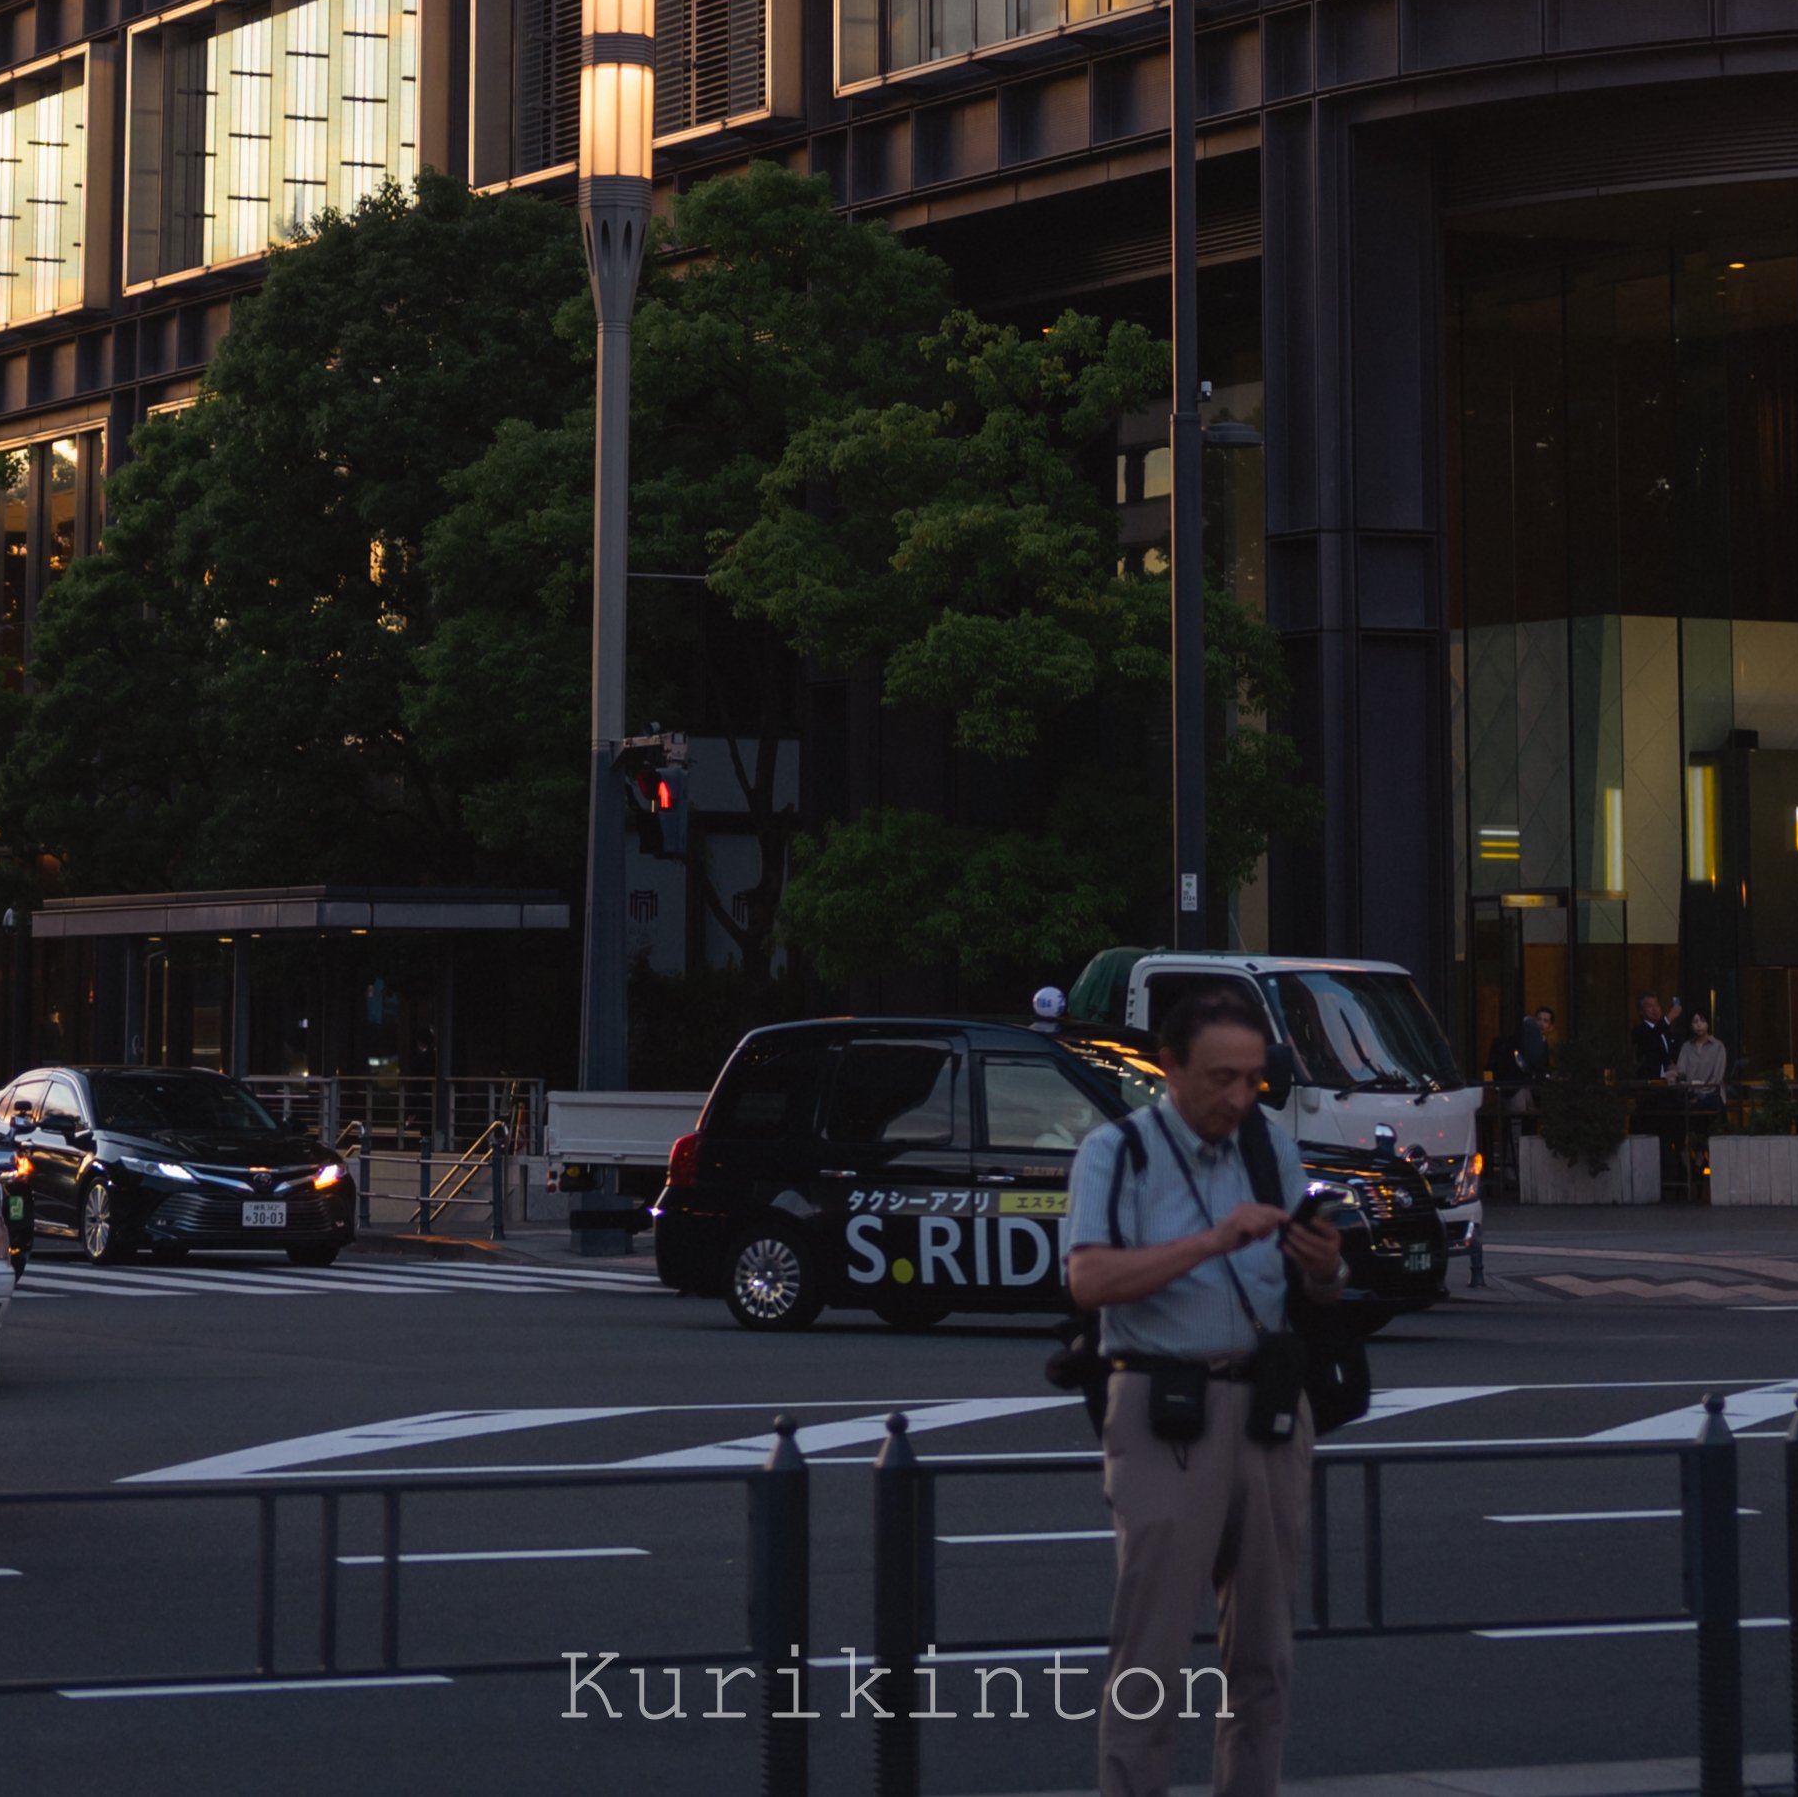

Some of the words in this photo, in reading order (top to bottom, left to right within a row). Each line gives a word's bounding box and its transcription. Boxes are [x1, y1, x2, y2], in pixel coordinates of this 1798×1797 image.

[848, 1189, 990, 1213] タクシーアプリ
